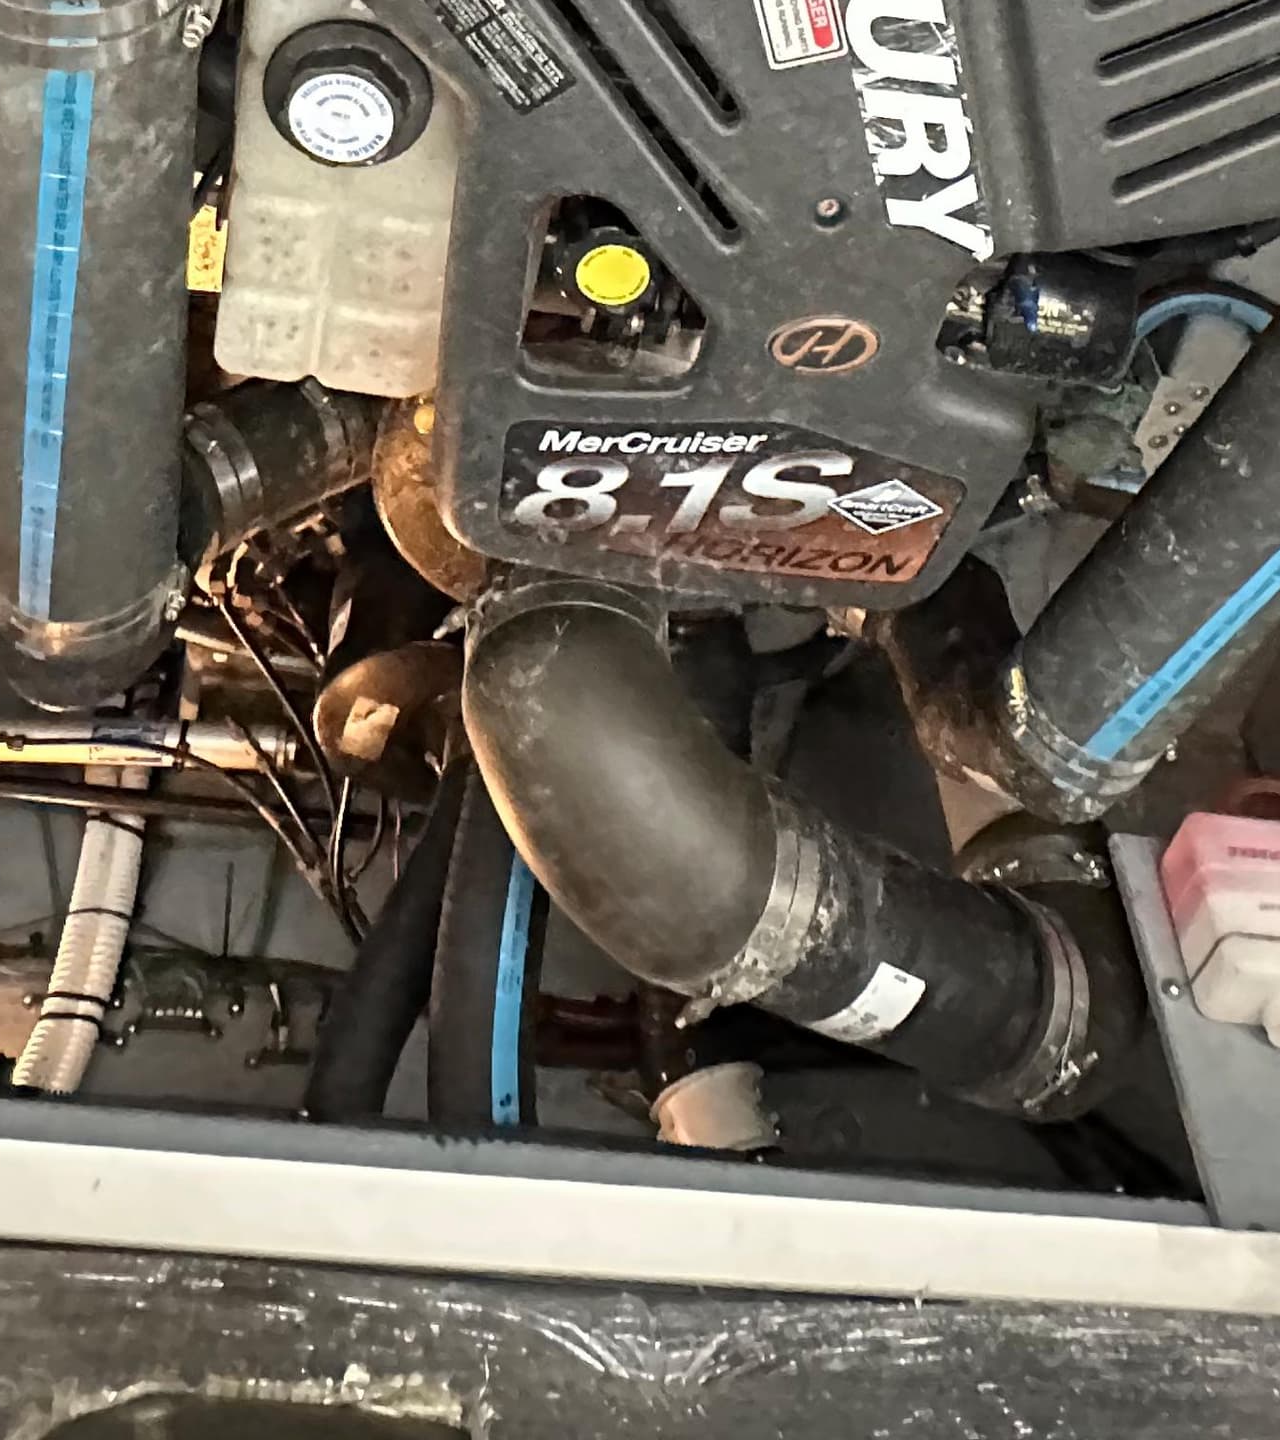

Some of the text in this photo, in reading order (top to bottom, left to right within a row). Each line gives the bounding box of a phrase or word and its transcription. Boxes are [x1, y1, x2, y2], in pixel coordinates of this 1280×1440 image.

[538, 430, 768, 454] MerCruiser
[514, 451, 854, 535] 8.1S
[660, 532, 916, 577] HORIZON
